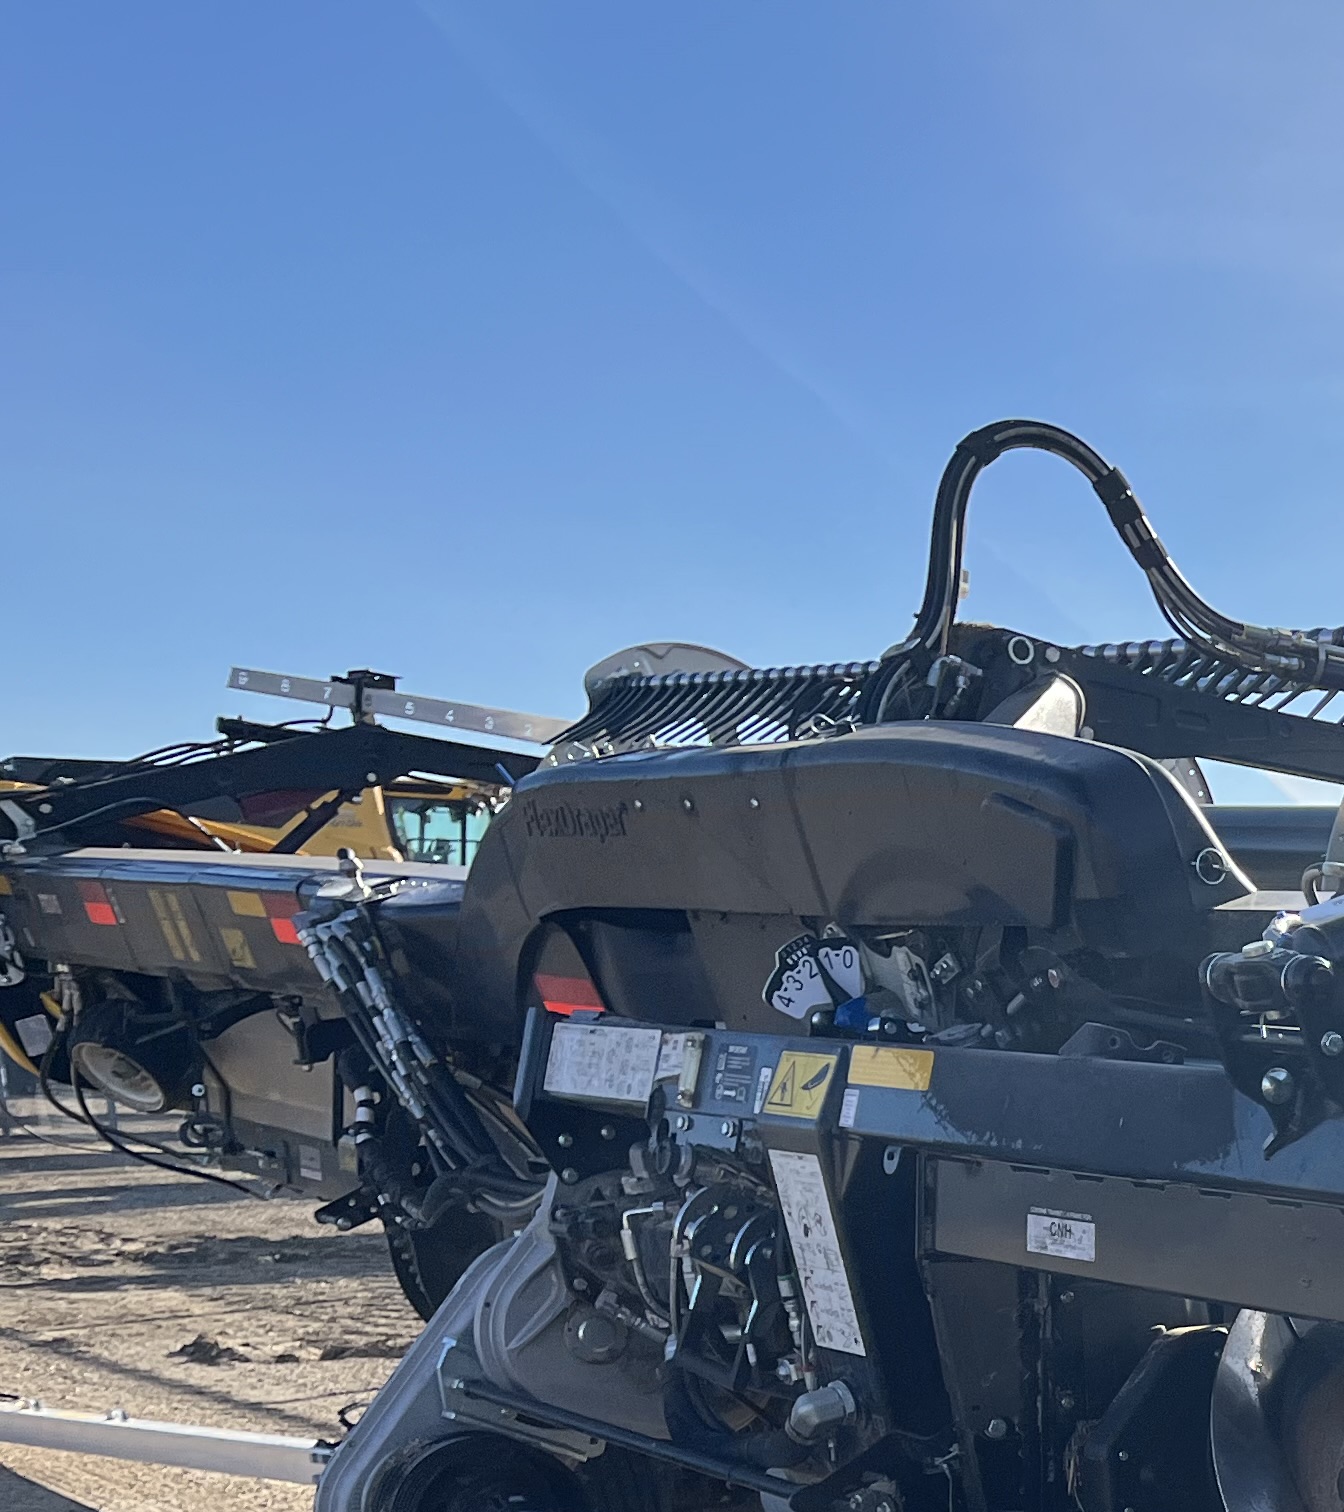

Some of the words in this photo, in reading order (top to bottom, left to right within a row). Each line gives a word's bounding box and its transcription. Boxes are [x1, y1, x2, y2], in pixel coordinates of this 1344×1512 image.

[280, 678, 291, 693] 8
[323, 686, 333, 700] 7
[404, 701, 415, 715] 5
[445, 709, 455, 722] 4
[524, 724, 533, 737] 2
[776, 994, 796, 1008] 4
[786, 975, 804, 991] 3
[802, 959, 819, 979] 2
[1049, 1221, 1072, 1239] CNH
